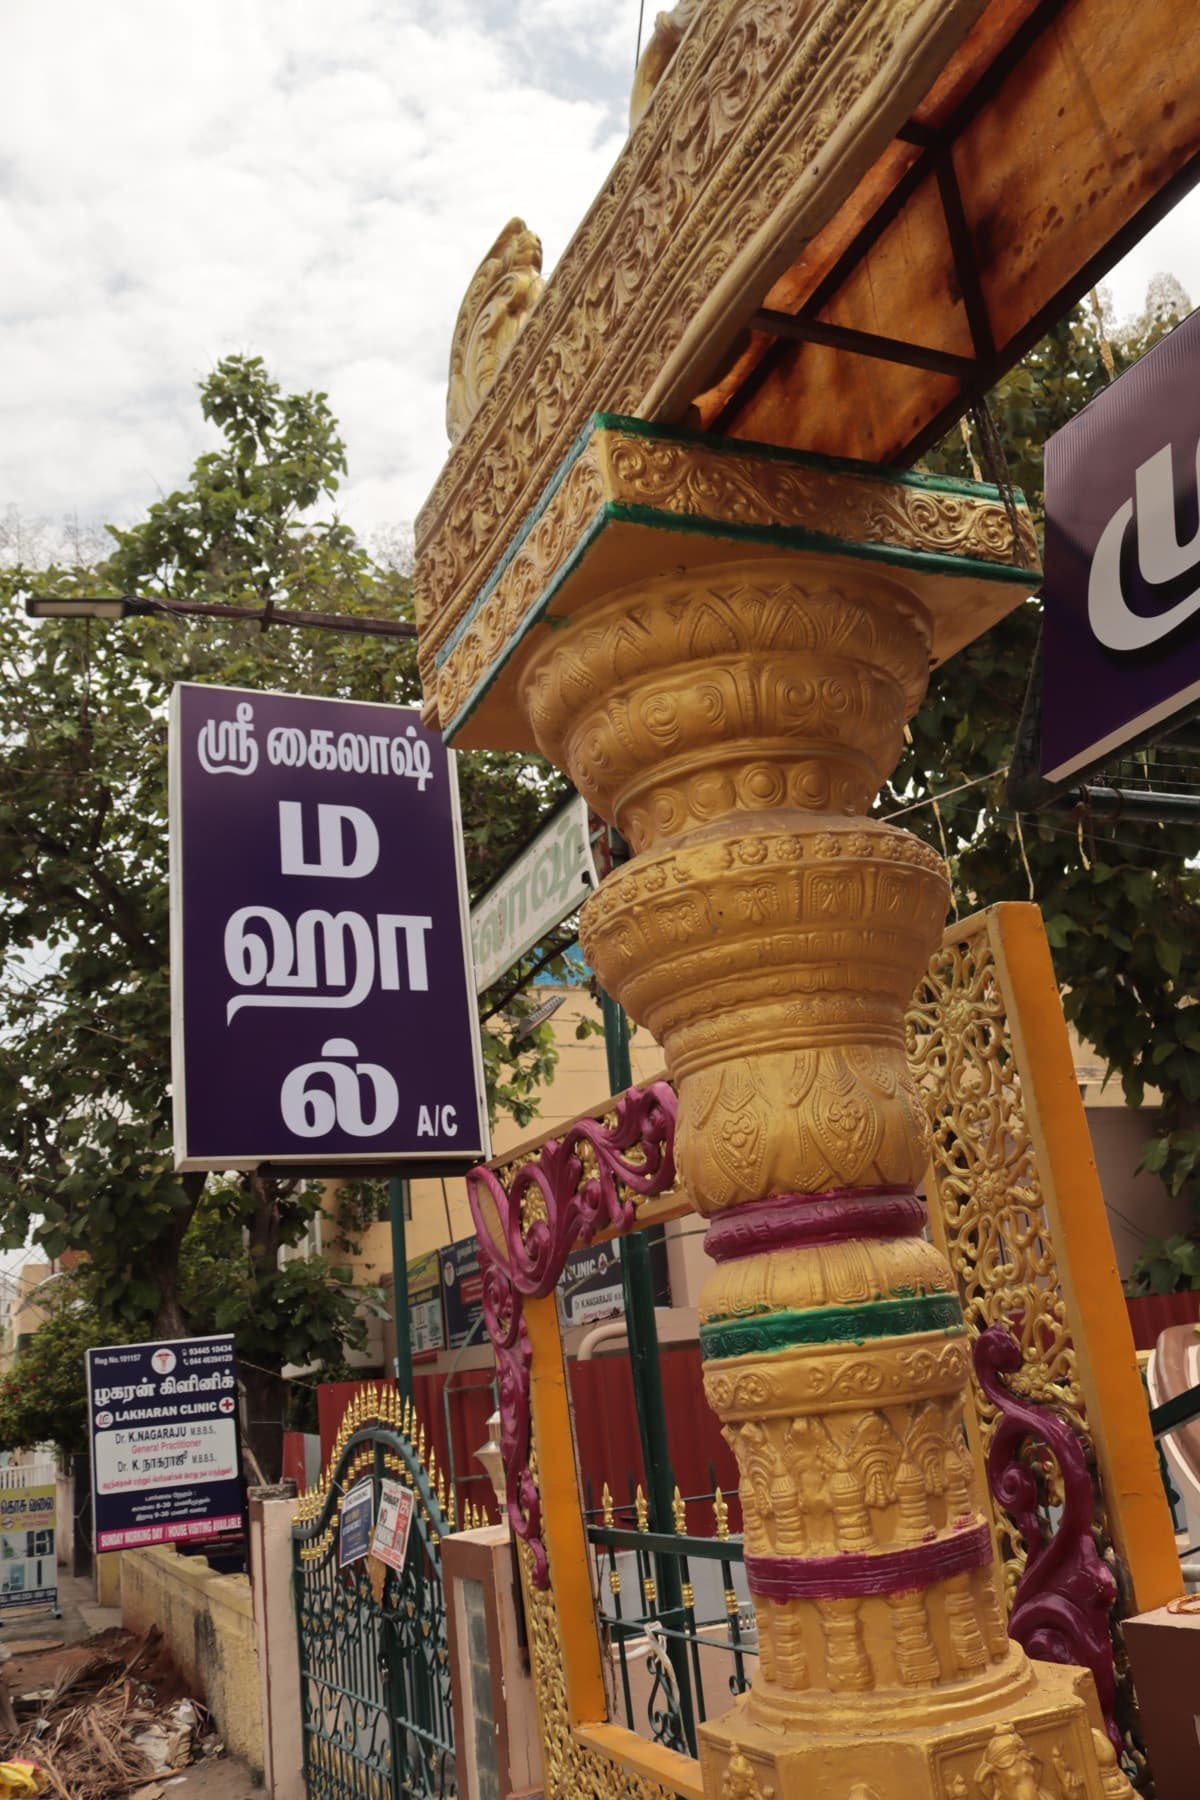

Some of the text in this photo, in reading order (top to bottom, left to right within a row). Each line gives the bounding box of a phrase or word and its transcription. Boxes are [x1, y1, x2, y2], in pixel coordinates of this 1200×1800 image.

[198, 702, 433, 791] ஸ்ரீ கைலாஷ்
[279, 801, 380, 879] ம
[281, 1038, 399, 1138] ல்
[417, 1104, 458, 1137] A/C
[94, 1369, 234, 1407] ழகரன் கிளினிக்
[115, 1406, 178, 1422] LAKHARAN
[180, 1401, 217, 1416] CLINIC
[128, 1427, 187, 1442] K.NAGARAJU
[131, 1438, 202, 1455] General Practitioner
